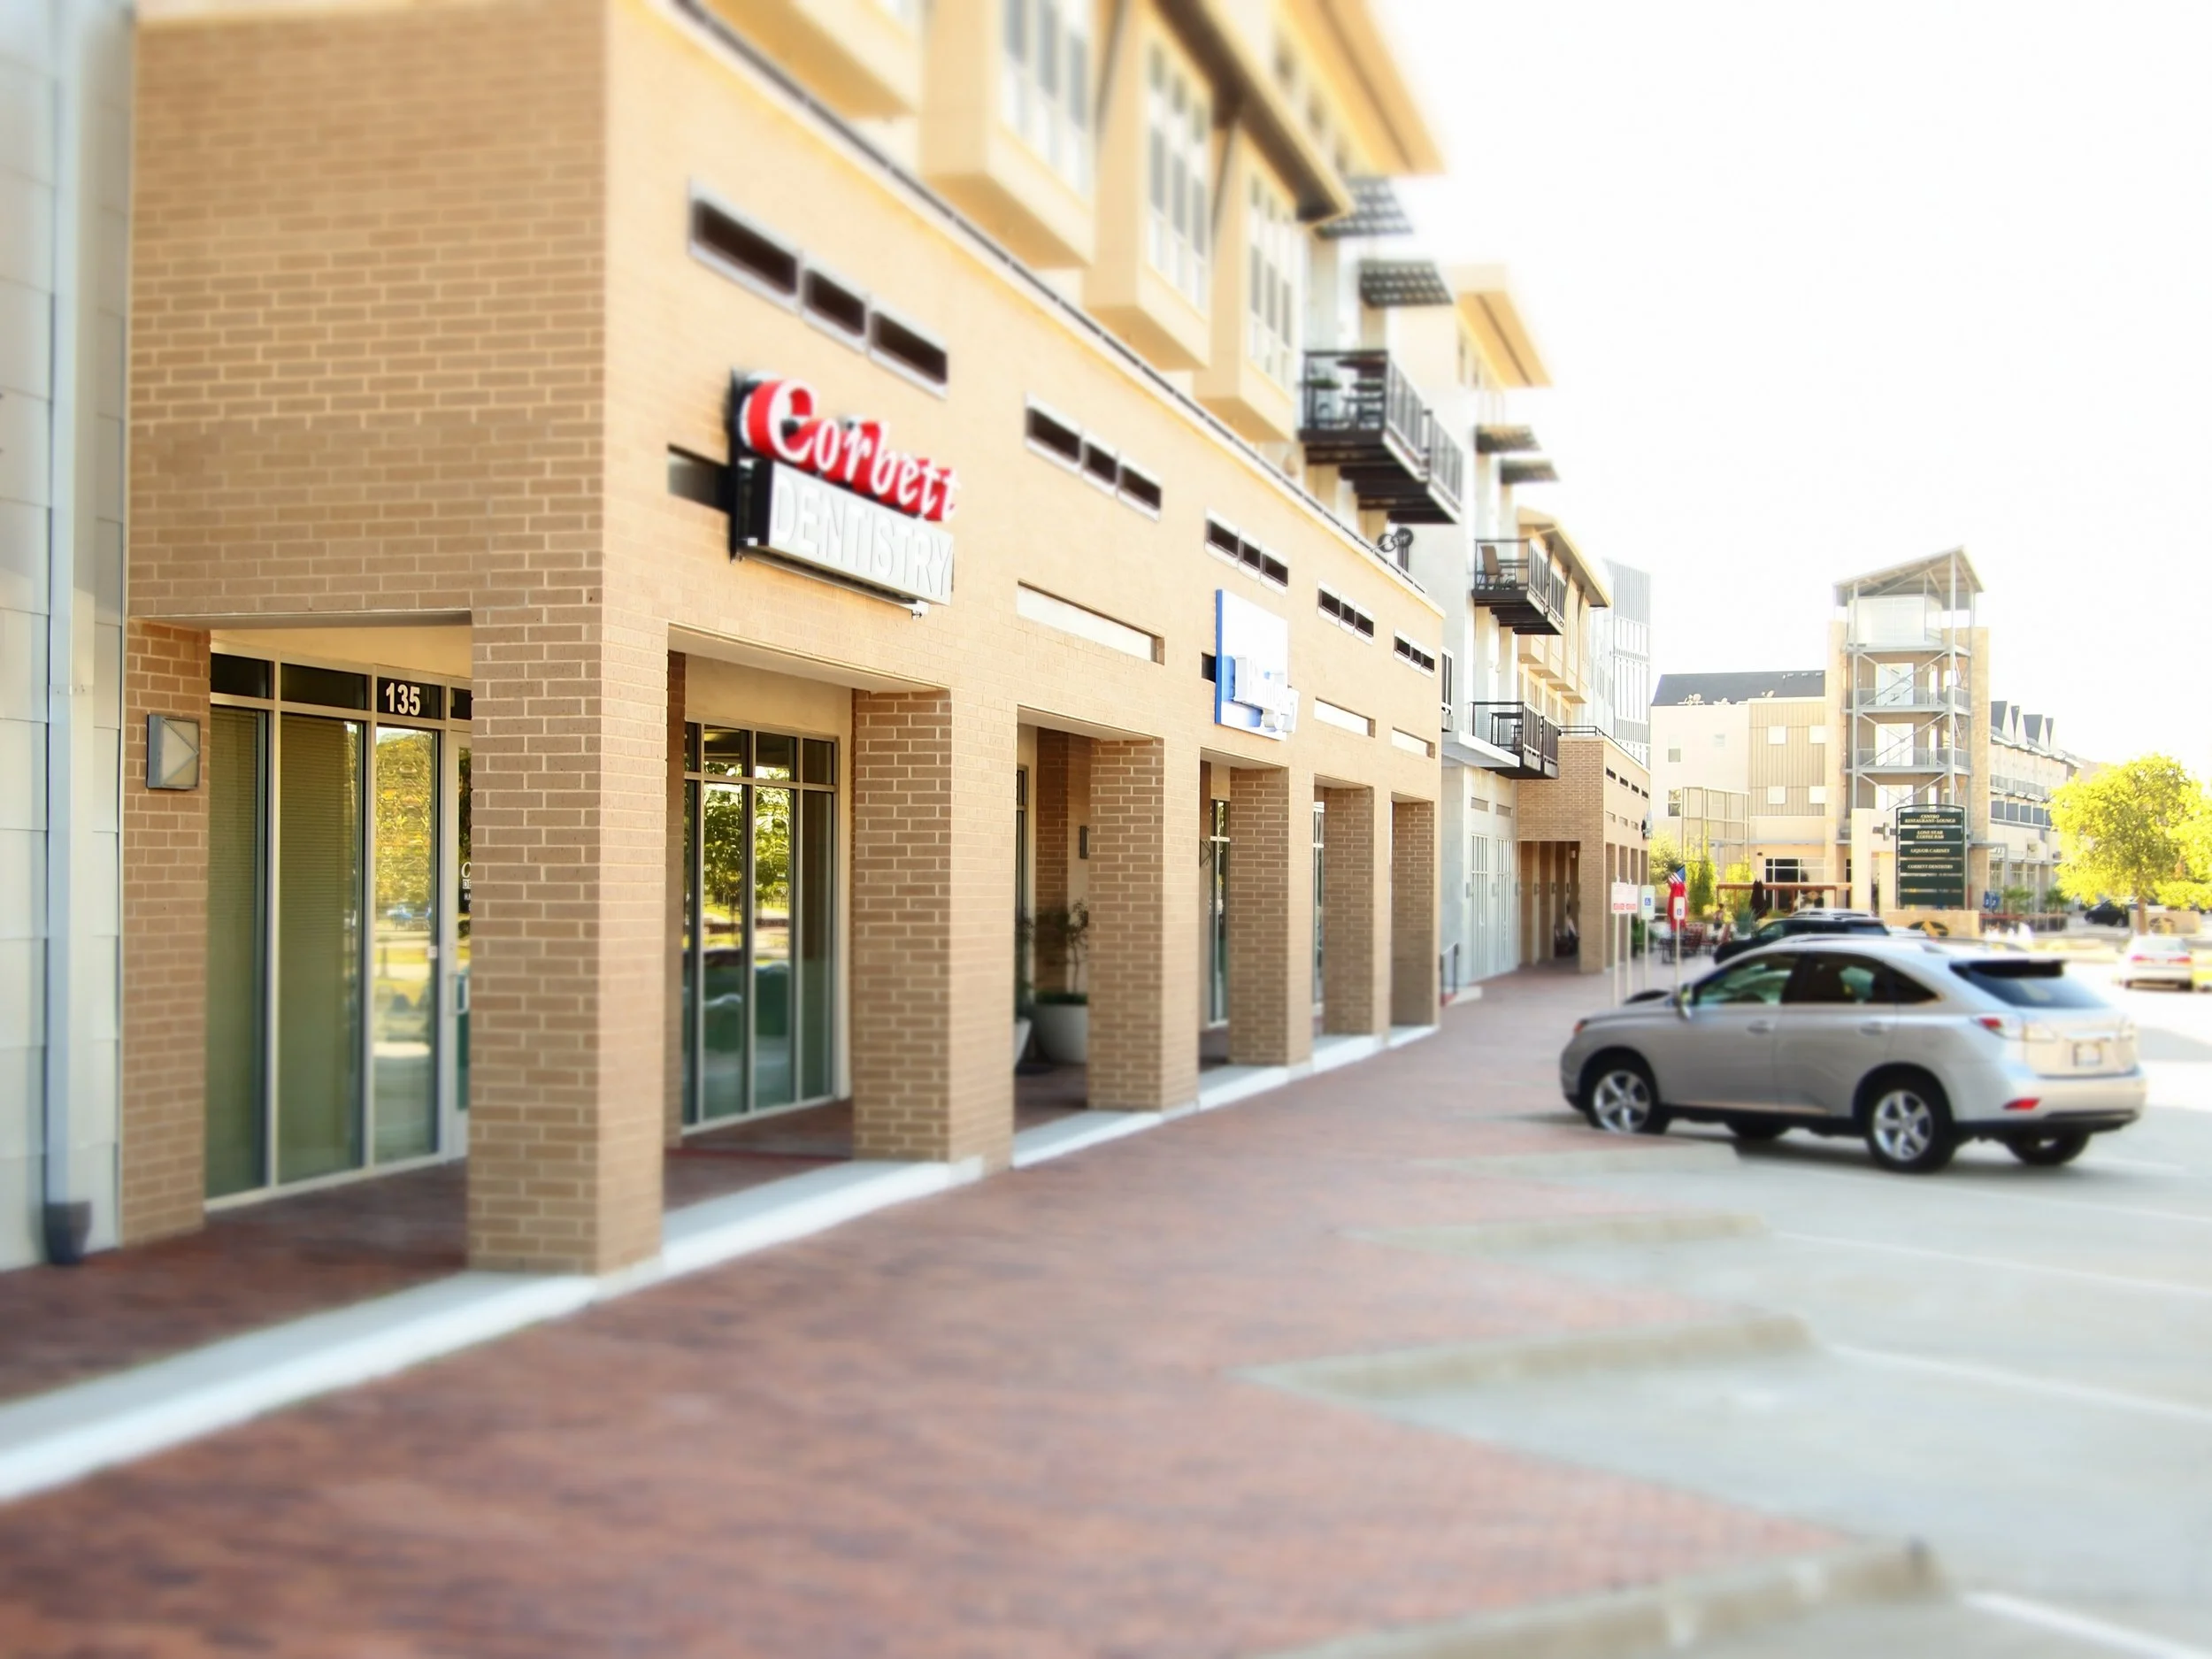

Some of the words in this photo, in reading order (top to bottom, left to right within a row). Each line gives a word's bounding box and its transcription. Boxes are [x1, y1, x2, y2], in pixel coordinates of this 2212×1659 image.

[746, 378, 962, 523] Corbett
[771, 472, 952, 596] DENTISTRY
[386, 682, 420, 716] 135
